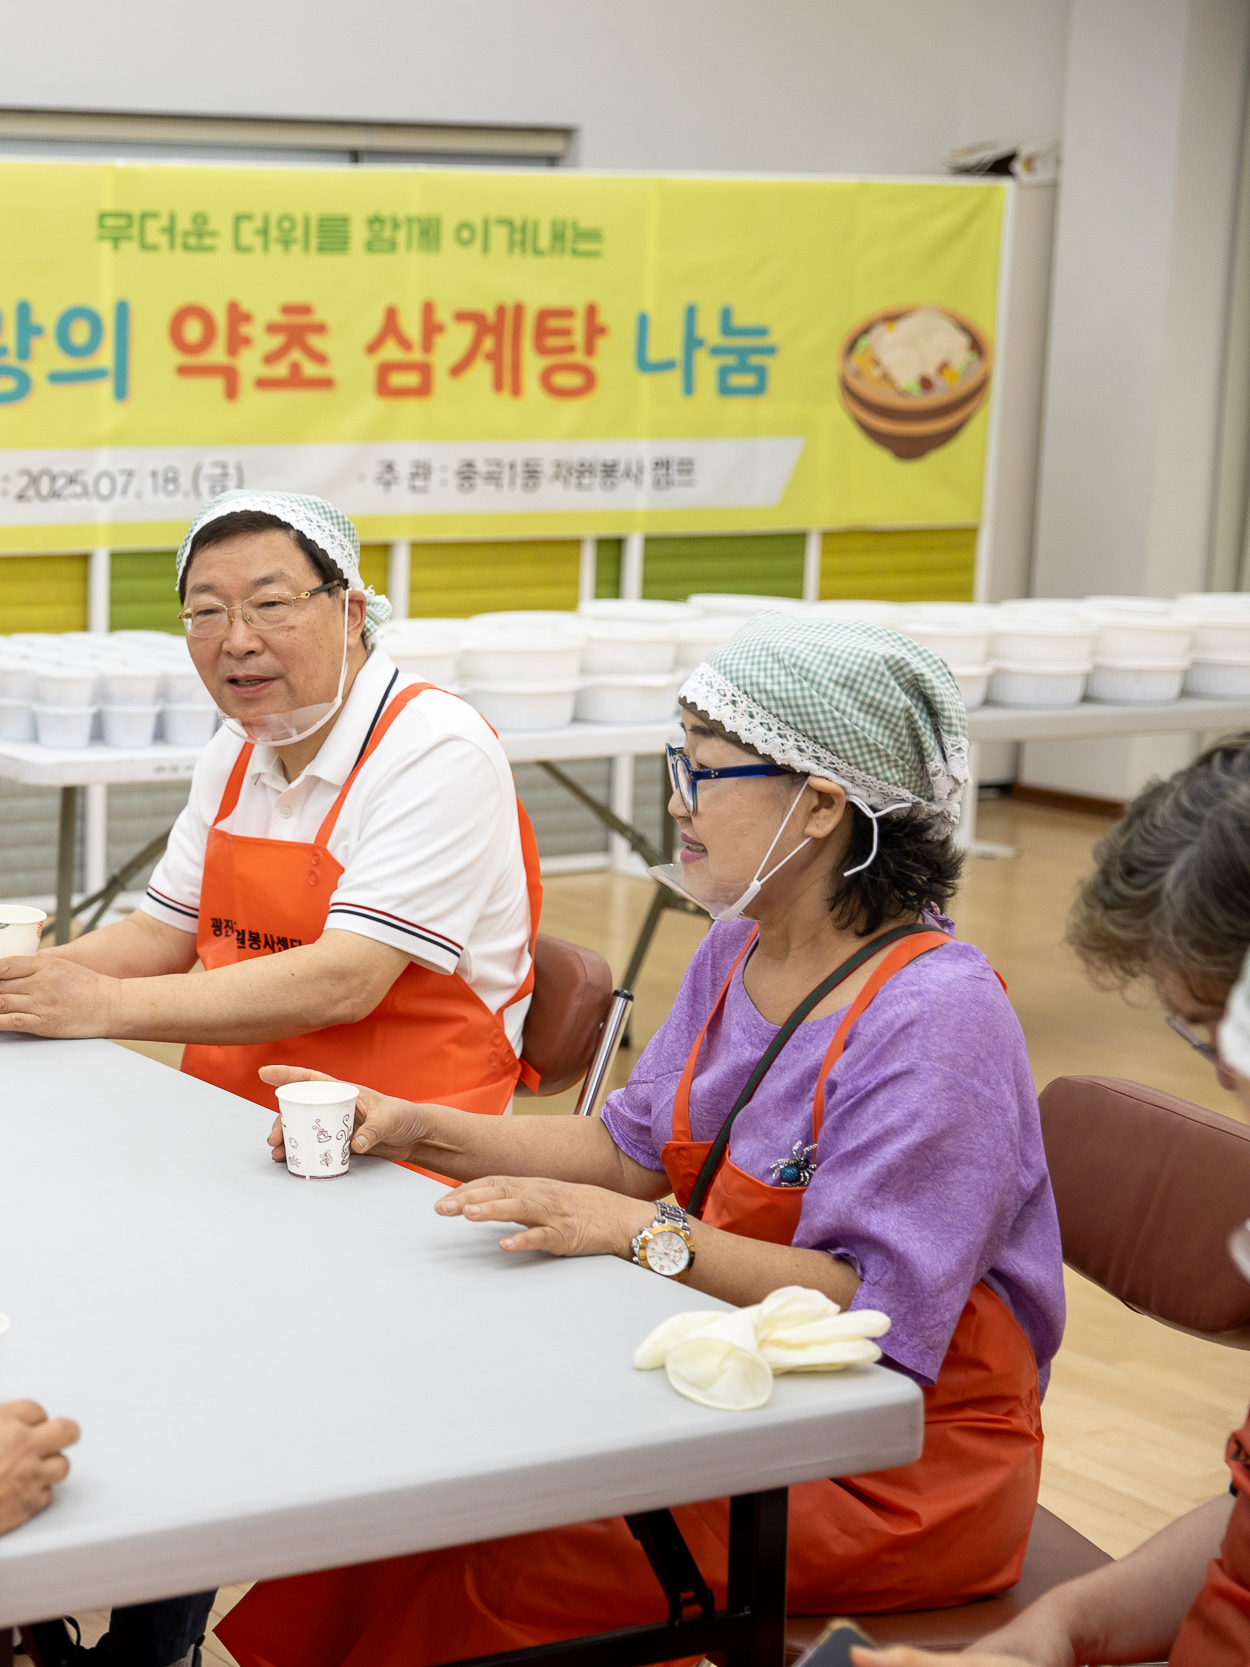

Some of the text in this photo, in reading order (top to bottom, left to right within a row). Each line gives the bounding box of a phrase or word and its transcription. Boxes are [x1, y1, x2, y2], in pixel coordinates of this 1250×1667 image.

[97, 211, 603, 258] 무더운 더위를 함께 이겨내는
[167, 299, 336, 403] 약초
[364, 299, 610, 401] 삼계탕
[633, 303, 779, 399] 나눔
